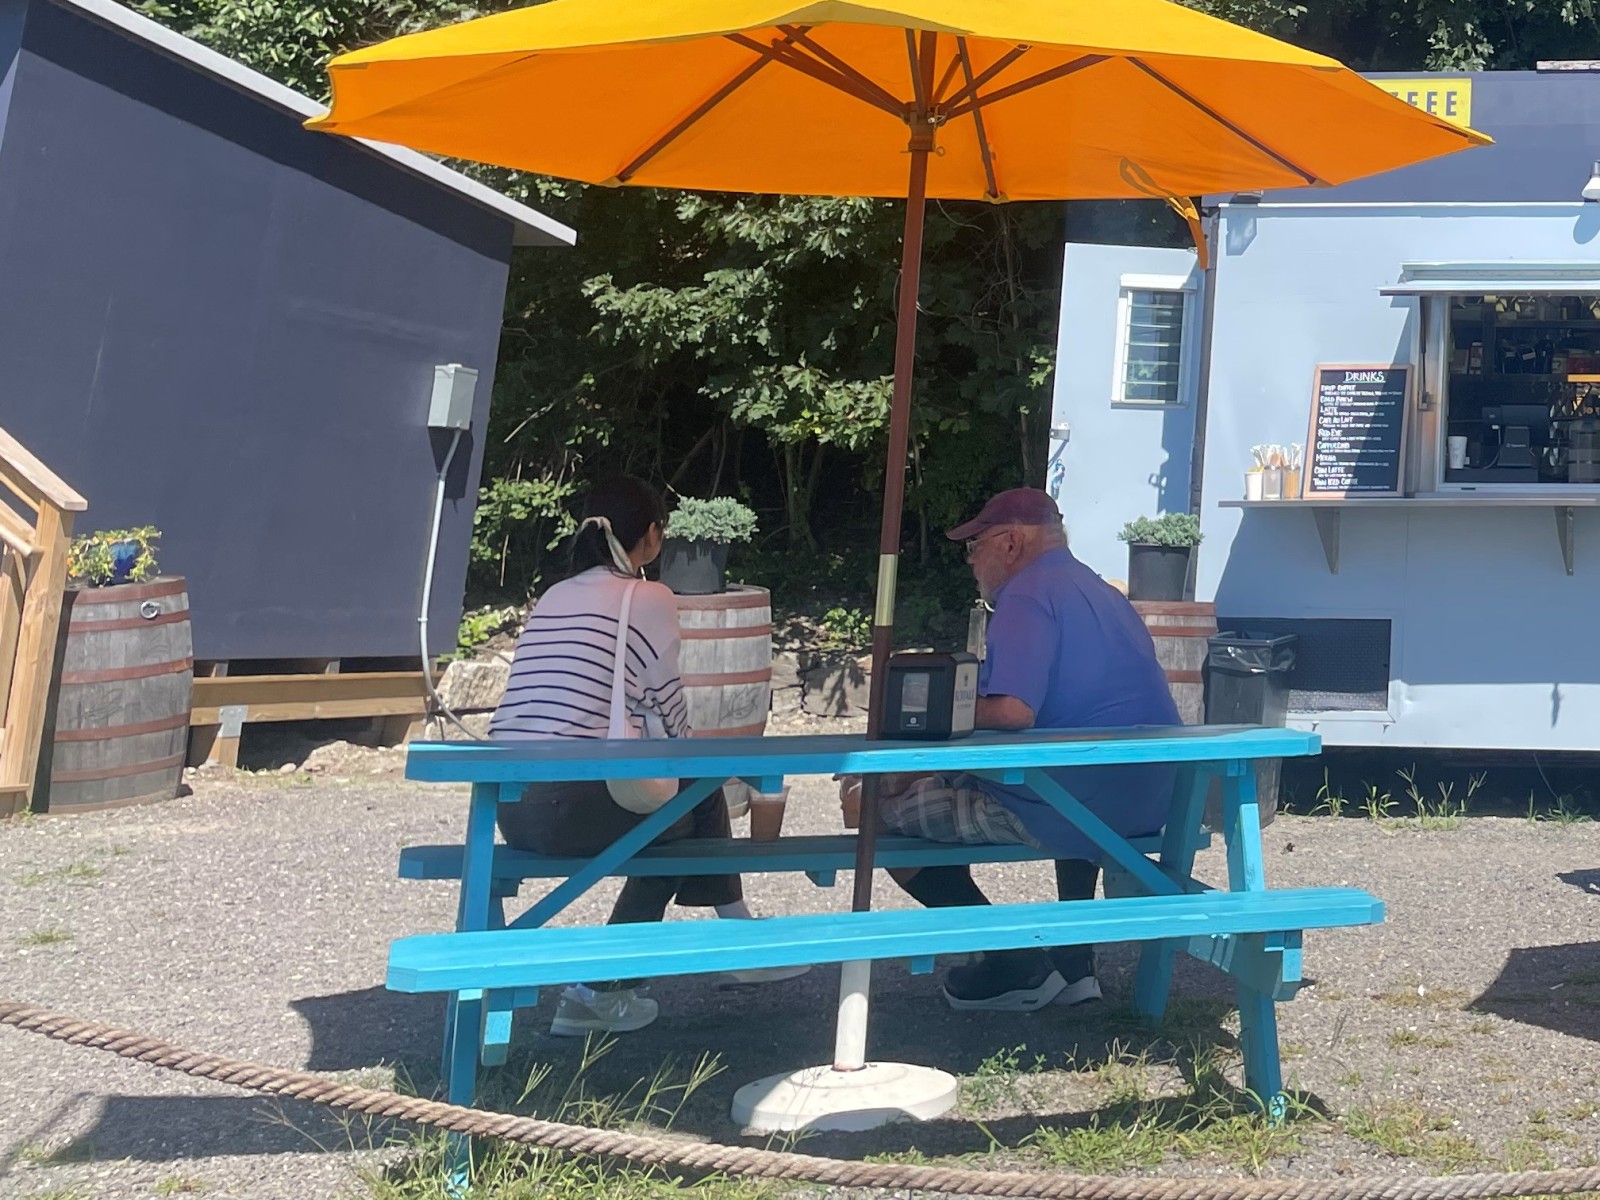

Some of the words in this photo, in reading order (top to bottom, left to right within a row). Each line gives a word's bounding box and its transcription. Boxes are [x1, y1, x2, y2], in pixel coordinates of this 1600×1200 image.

[1390, 91, 1457, 116] FEE
[1345, 371, 1384, 382] DRINKS
[1316, 454, 1336, 462] MOCHA
